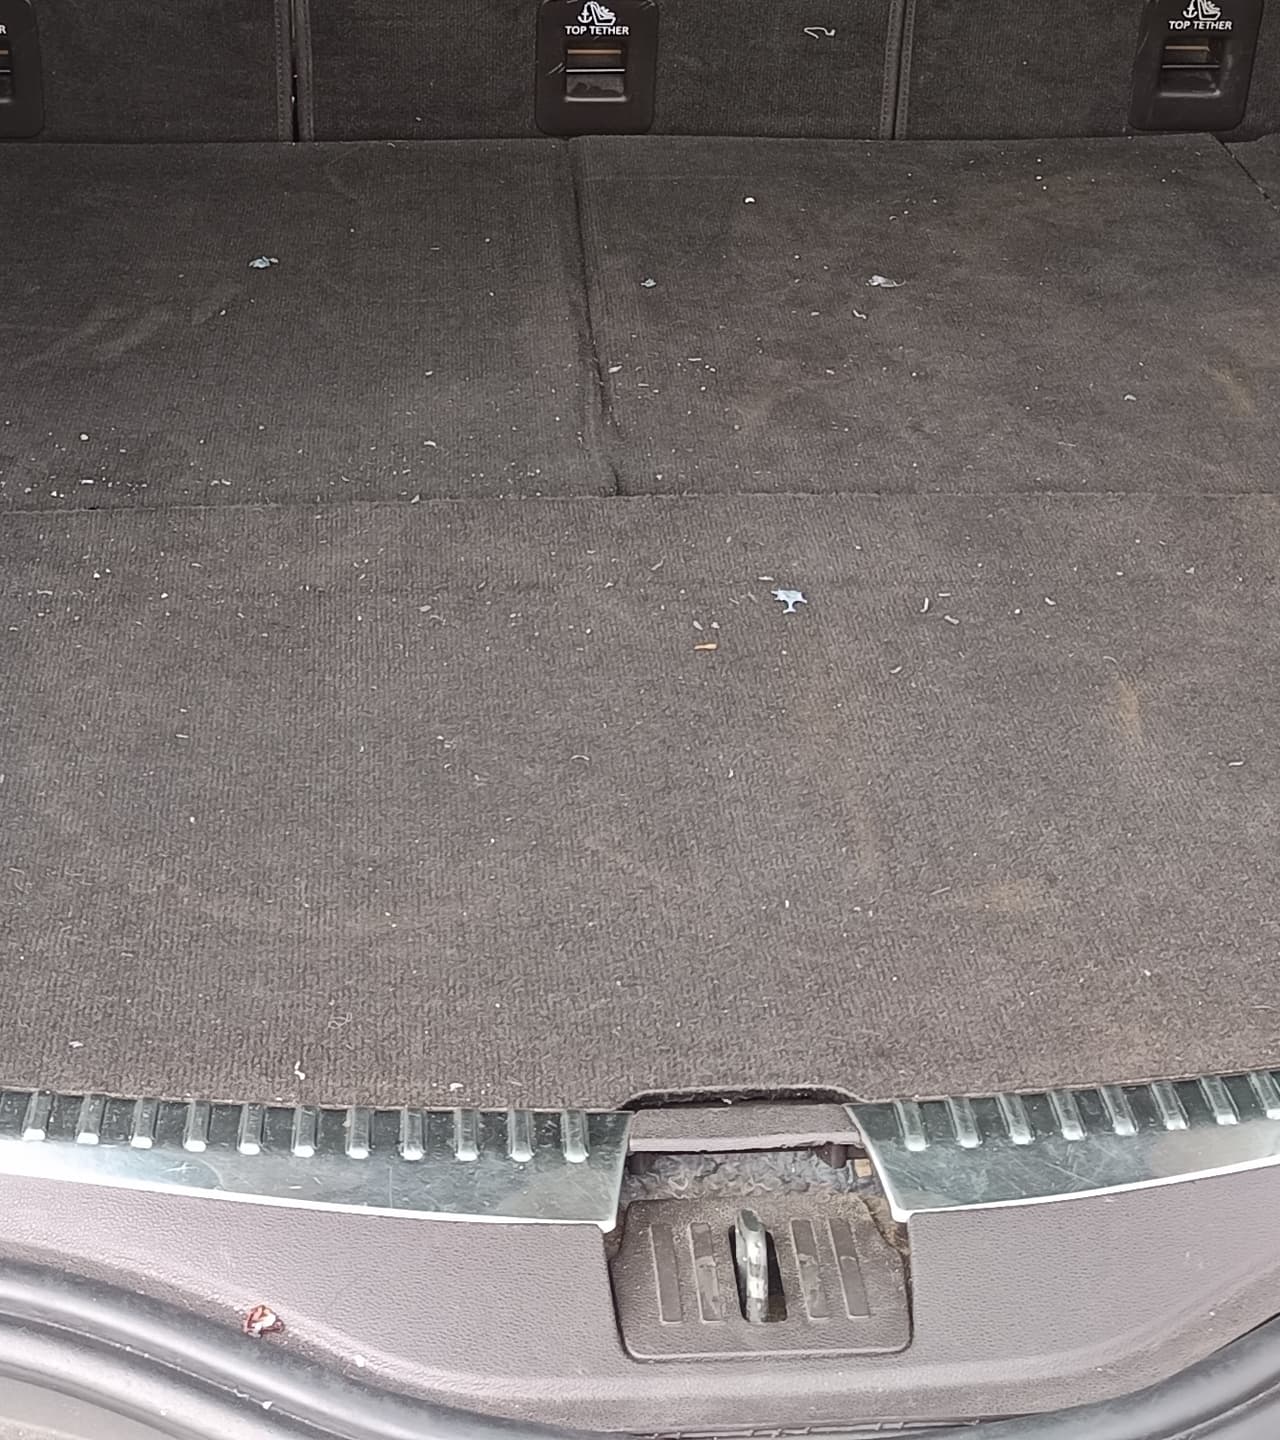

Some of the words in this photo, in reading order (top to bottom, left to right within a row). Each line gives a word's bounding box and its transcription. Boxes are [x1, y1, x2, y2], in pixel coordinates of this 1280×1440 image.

[565, 25, 587, 35] TOP
[589, 25, 629, 35] TETHER
[1169, 20, 1190, 30] TOP
[1193, 20, 1232, 30] TETHER
